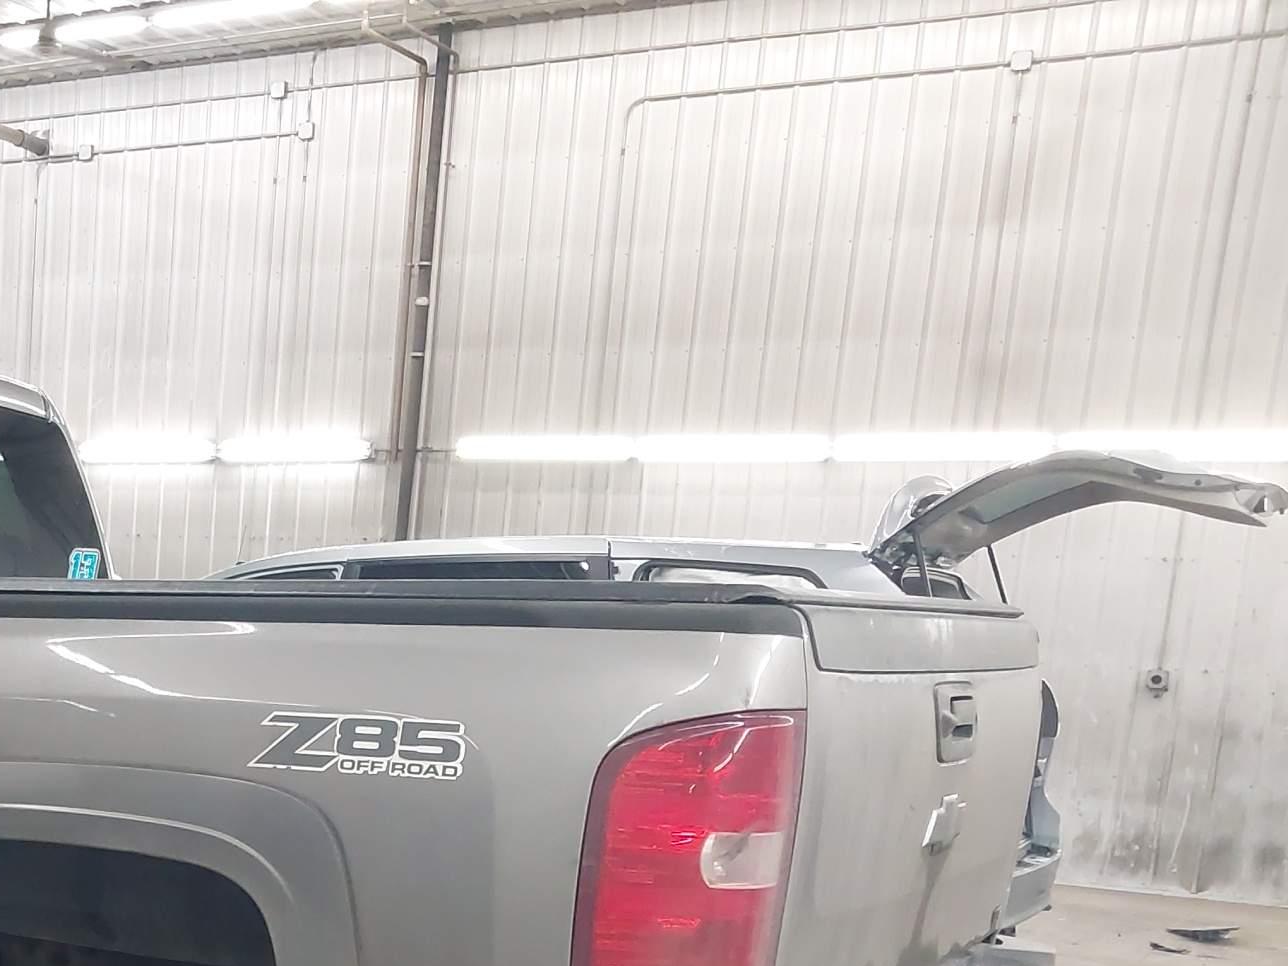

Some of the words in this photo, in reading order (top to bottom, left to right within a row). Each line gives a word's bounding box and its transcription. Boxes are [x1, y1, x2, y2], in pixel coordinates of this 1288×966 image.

[247, 711, 466, 772] Z85
[338, 758, 386, 775] OFF
[389, 760, 462, 780] ROAD
